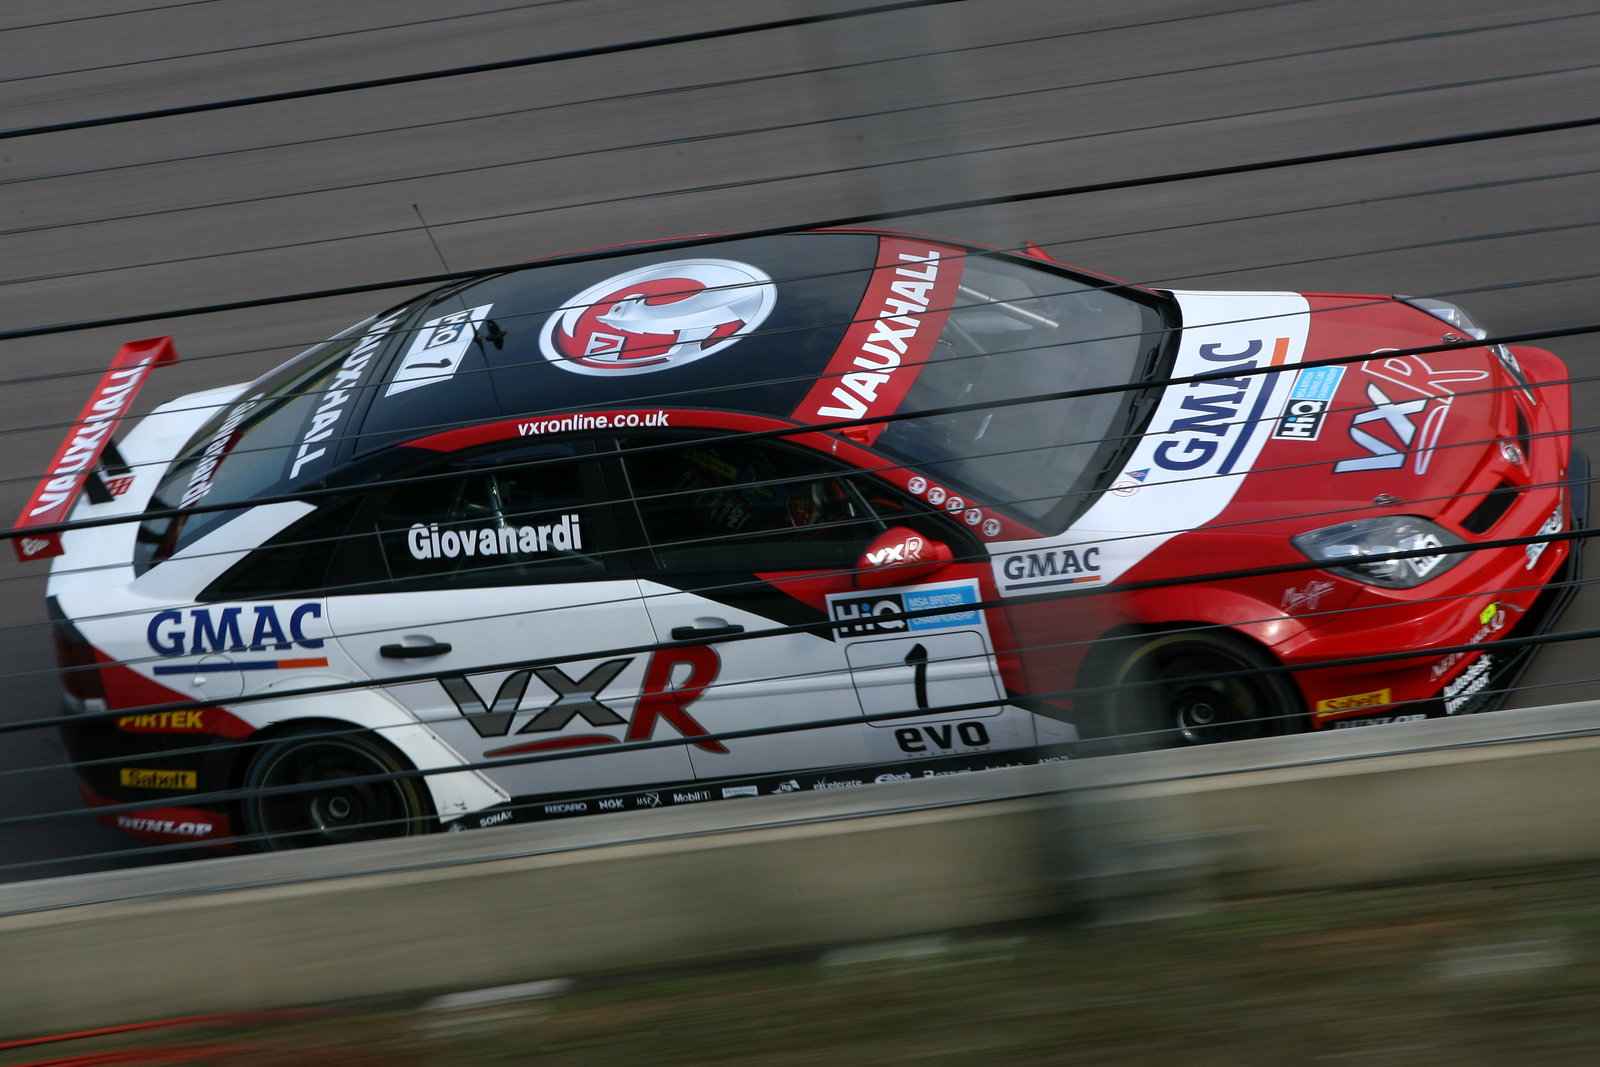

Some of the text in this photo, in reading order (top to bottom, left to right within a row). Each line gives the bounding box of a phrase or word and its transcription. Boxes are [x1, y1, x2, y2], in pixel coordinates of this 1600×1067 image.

[818, 252, 940, 419] VAUXHALL
[404, 358, 453, 370] 1
[290, 307, 408, 479] VAUXHALL
[1154, 339, 1263, 471] GMAC
[518, 410, 669, 437] vxronline.co.uk
[1281, 401, 1323, 436] HiQ
[30, 356, 152, 517] VAUXHALL
[408, 513, 582, 560] Giovanardi
[865, 537, 924, 567] VXR
[1003, 547, 1101, 580] GMAC
[930, 593, 962, 606] BRITISH
[147, 602, 326, 658] GMAC
[835, 600, 906, 633] HiQ
[904, 643, 930, 710] 1
[437, 642, 731, 756] VXR
[118, 710, 205, 729] PIRTEK
[894, 721, 991, 753] evo
[128, 771, 189, 788] Sabelt
[544, 802, 587, 814] RECARO
[598, 798, 625, 811] NGK
[673, 792, 701, 804] Mobil
[116, 815, 214, 837] DUNLOP
[480, 810, 513, 828] SONAX
